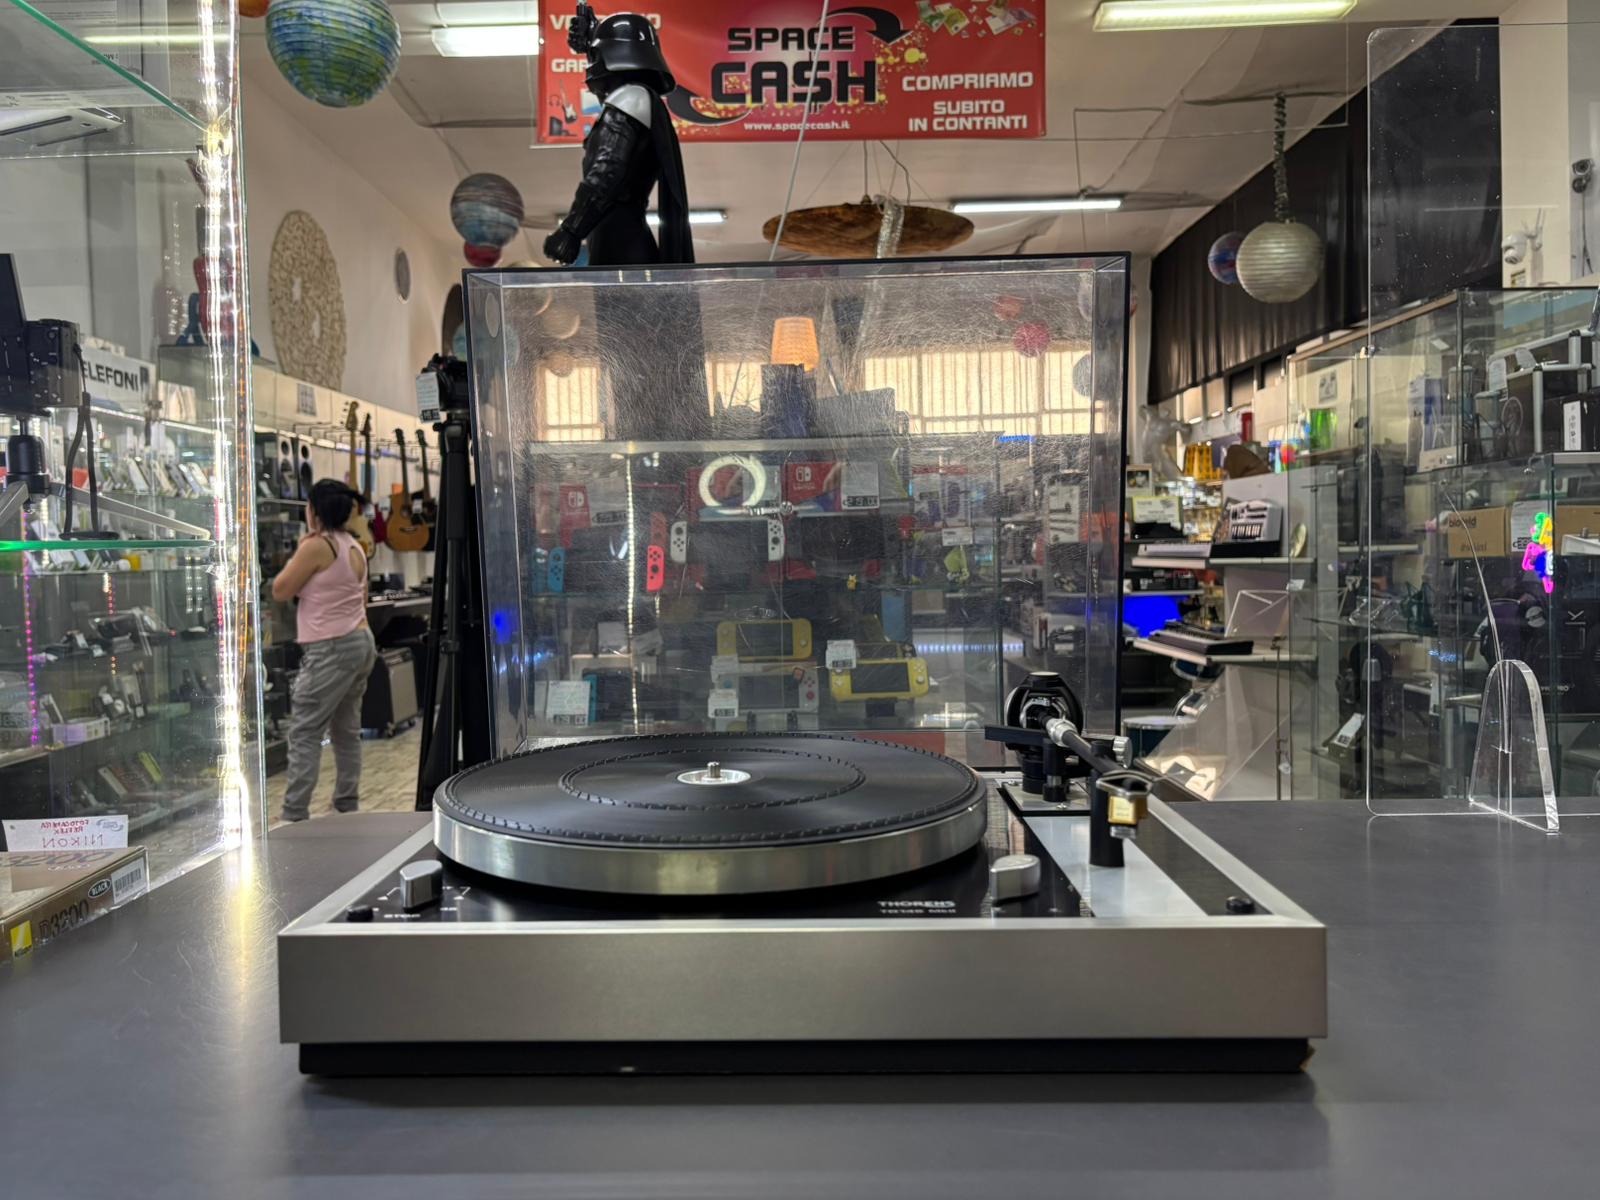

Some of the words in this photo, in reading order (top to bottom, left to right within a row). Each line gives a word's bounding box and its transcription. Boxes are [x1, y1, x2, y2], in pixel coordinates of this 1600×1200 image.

[728, 26, 854, 51] SPACE
[711, 60, 878, 103] CASH
[902, 71, 1034, 92] COMPRIAMO
[933, 99, 1005, 115] SUBITO
[744, 121, 850, 131] www.spacecash.it
[908, 118, 929, 132] IN
[932, 115, 1028, 131] CONTANTI
[83, 360, 139, 392] ELEFONI
[877, 900, 956, 908] THORENS
